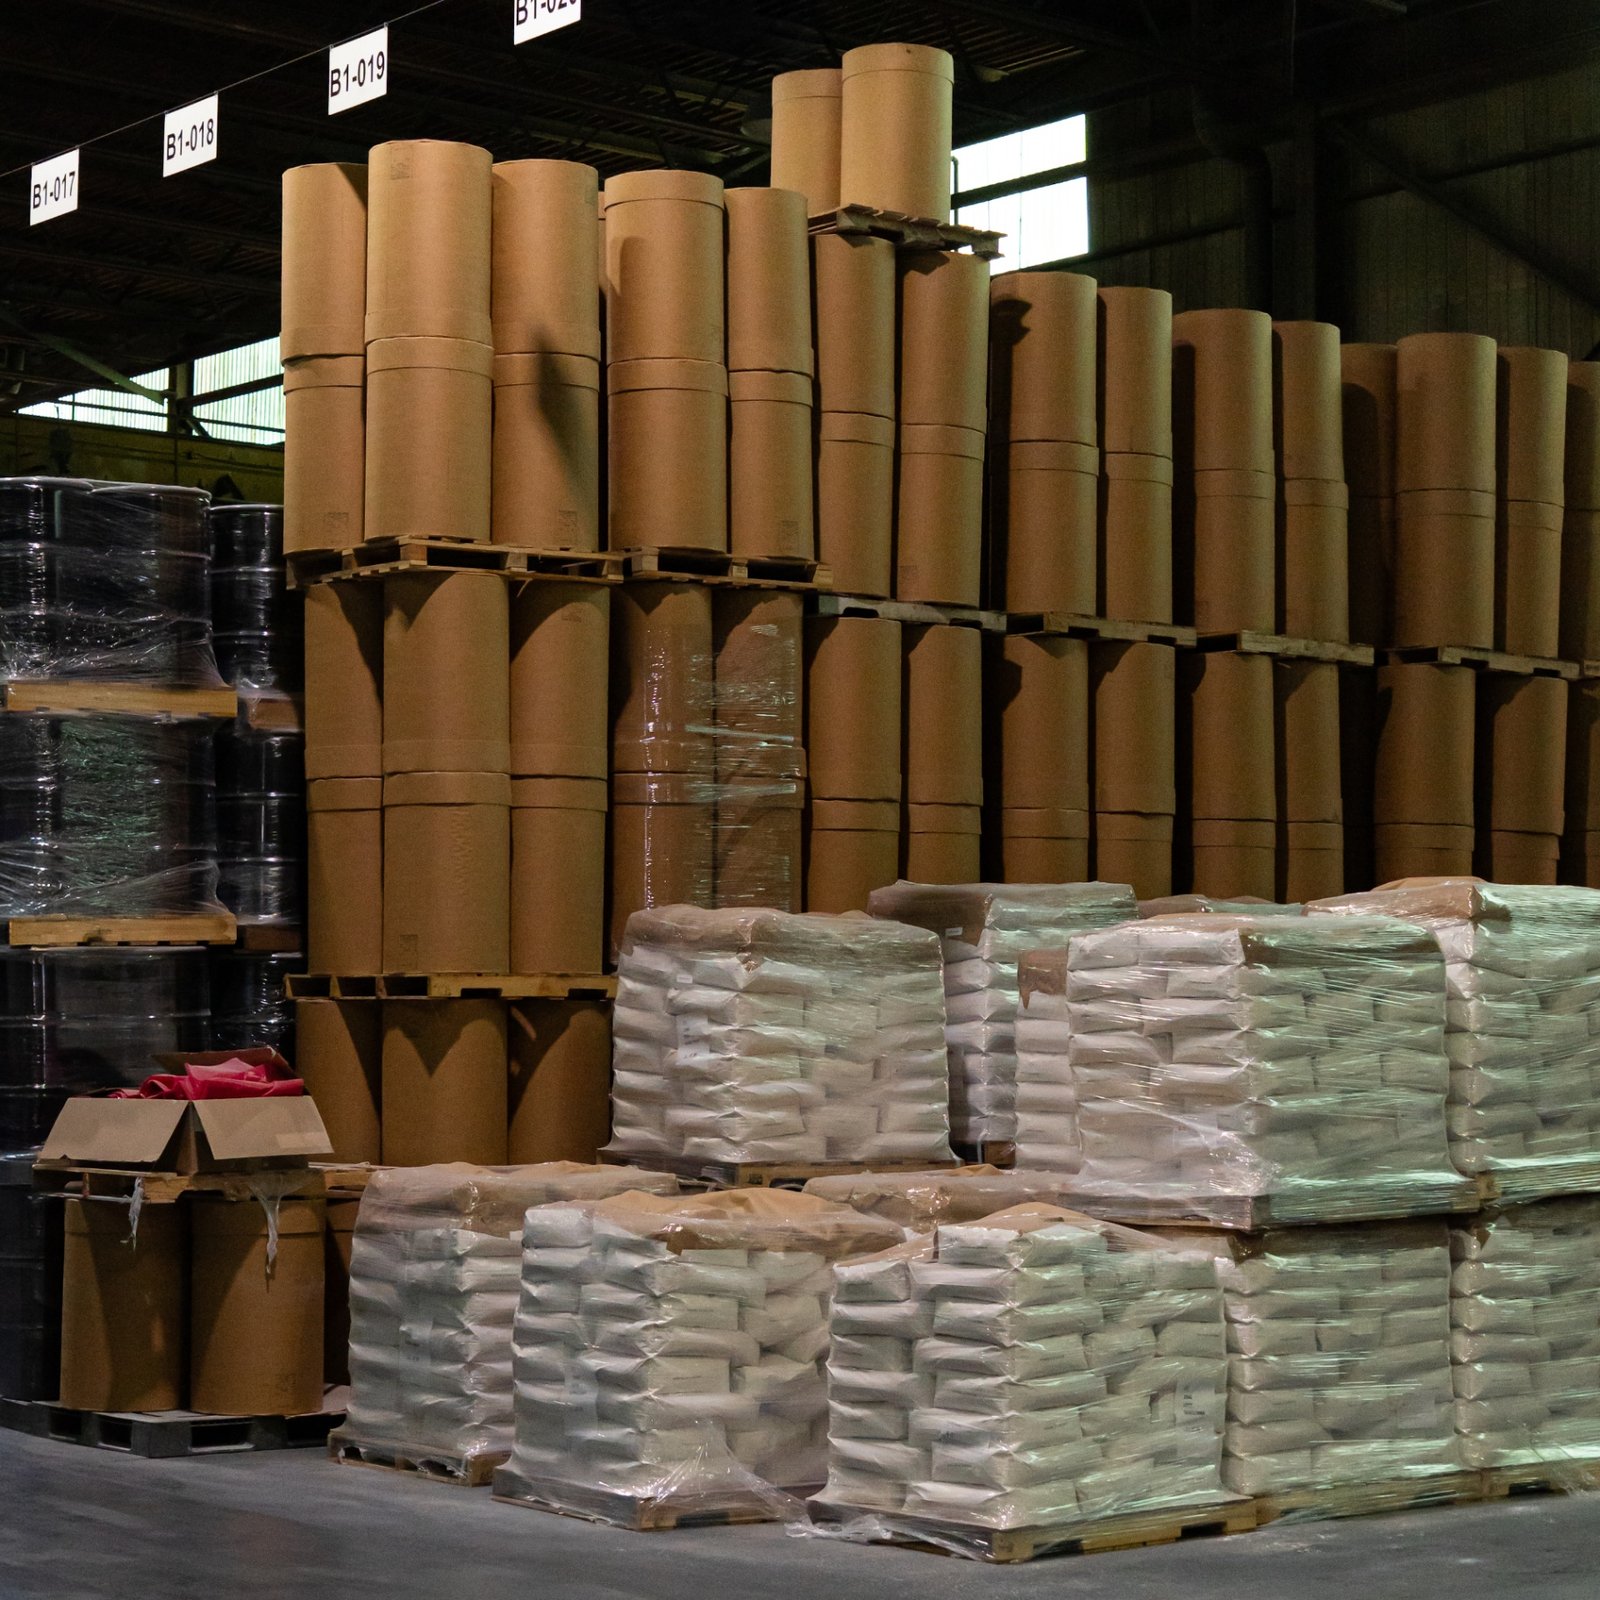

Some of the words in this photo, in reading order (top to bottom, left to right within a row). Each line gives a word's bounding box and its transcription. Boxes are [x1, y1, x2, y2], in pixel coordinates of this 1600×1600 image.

[330, 51, 385, 98] B1-019
[167, 118, 214, 160] B1-018
[33, 171, 76, 209] B1-017
